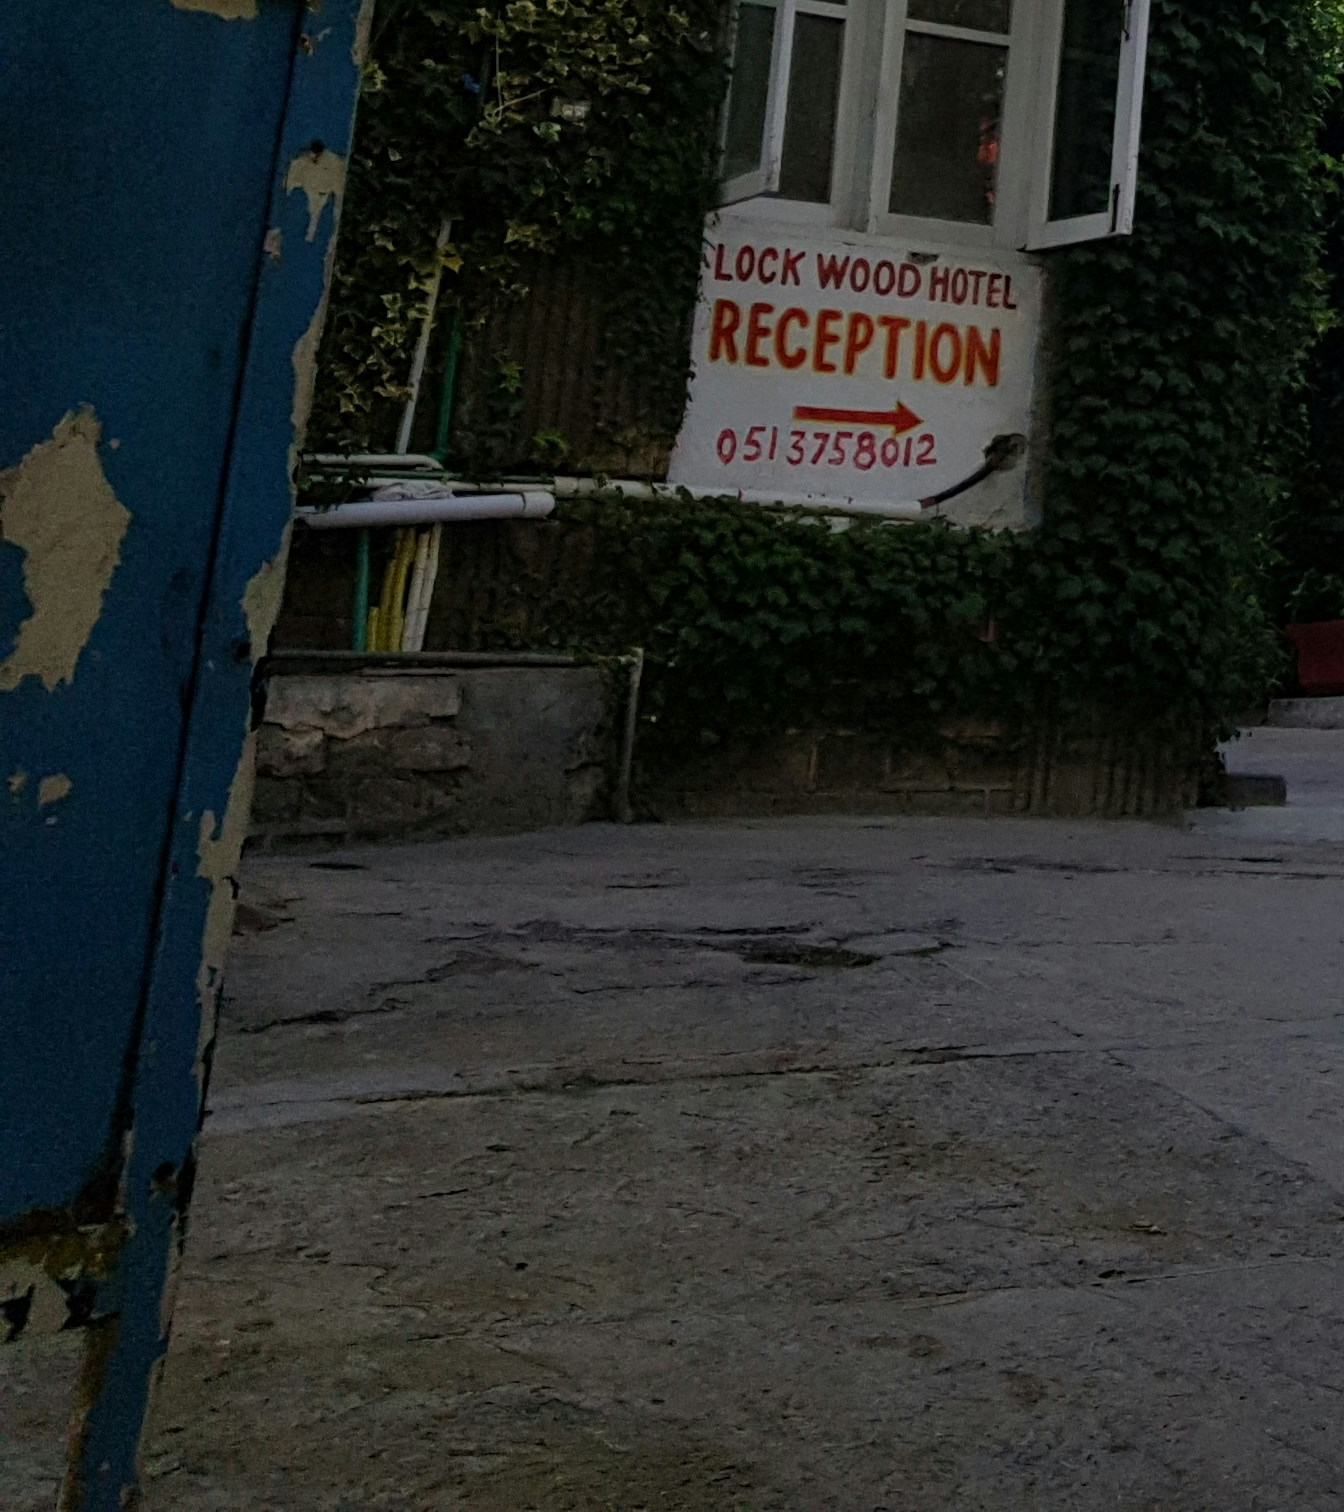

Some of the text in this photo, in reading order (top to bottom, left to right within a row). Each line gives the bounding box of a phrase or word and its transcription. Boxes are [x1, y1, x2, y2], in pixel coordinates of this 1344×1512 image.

[714, 243, 1017, 310] LOCK WOOD HOTEL
[709, 298, 1001, 387] RECEPTION
